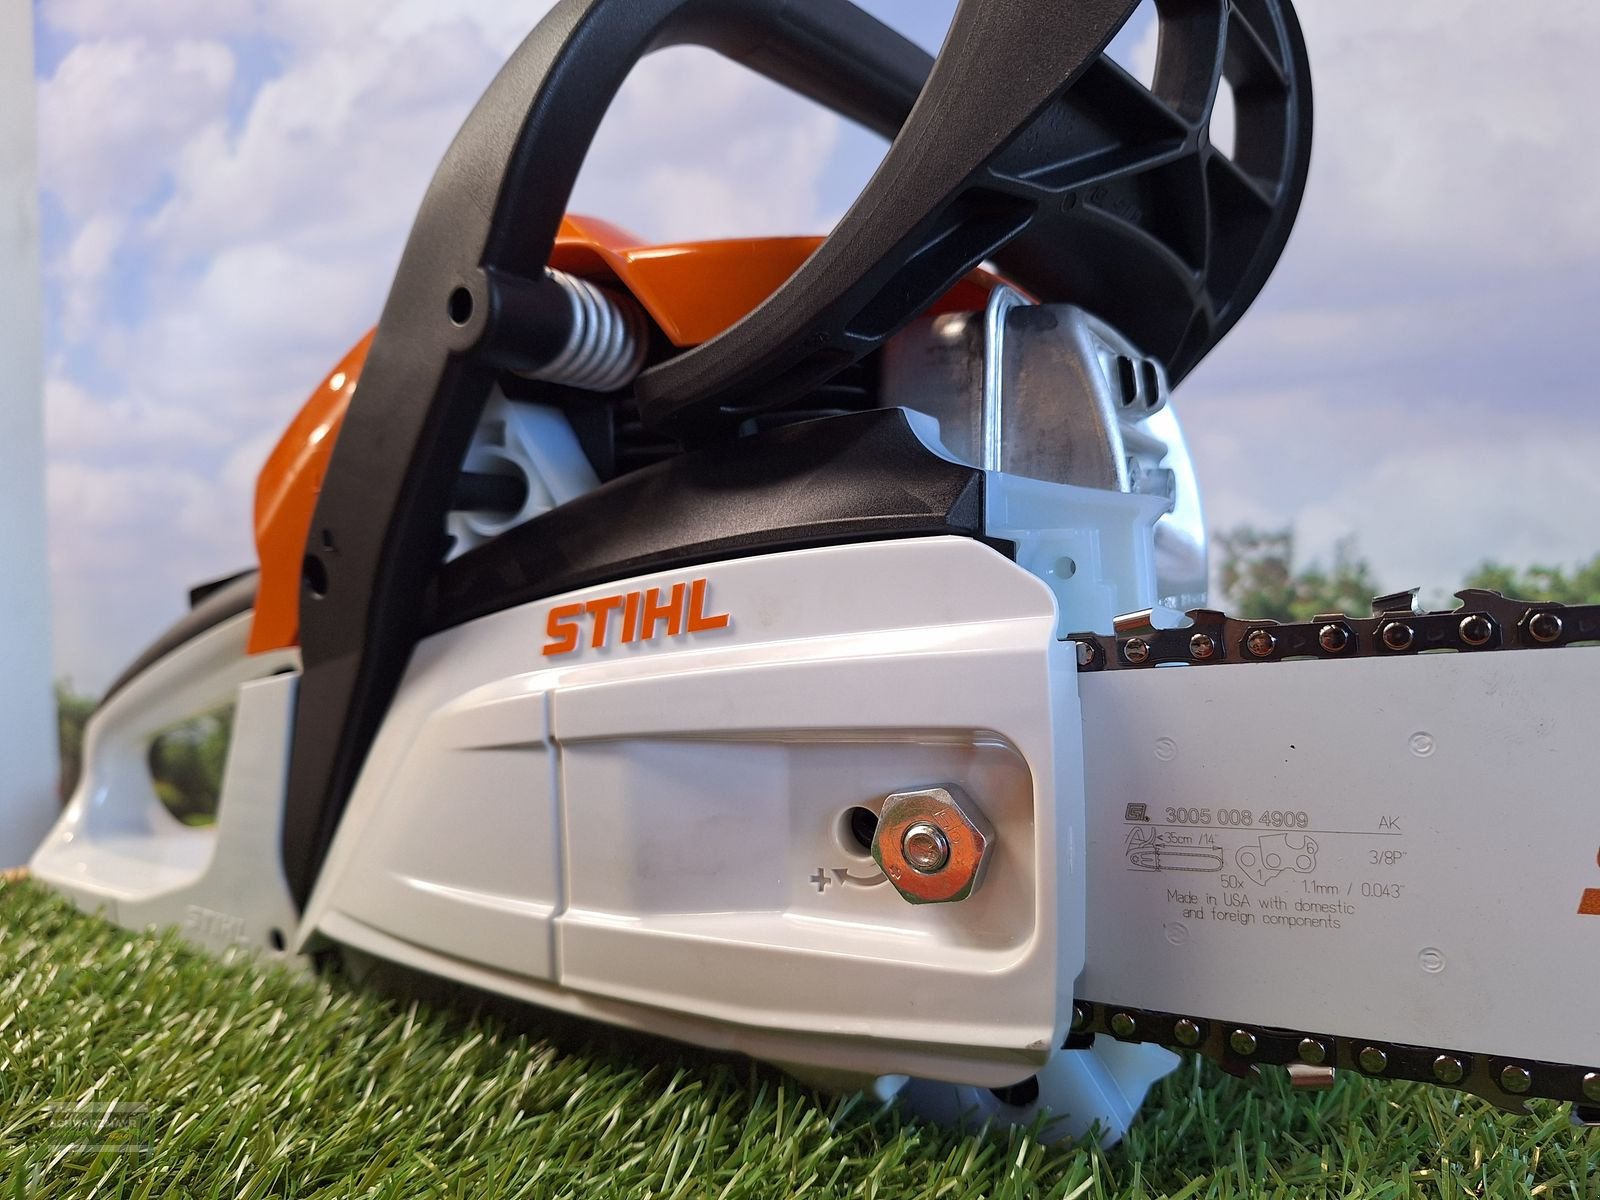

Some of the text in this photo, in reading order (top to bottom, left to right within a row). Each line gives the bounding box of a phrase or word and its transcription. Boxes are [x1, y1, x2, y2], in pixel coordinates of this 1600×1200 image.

[542, 578, 730, 656] STIHL
[1165, 806, 1309, 828] 3005 008 4909
[1378, 815, 1401, 830] AK
[1165, 831, 1193, 844] 35cm
[1220, 873, 1245, 889] 50x
[1302, 879, 1339, 895] 1.1mm
[1166, 888, 1356, 915] Made in USA with domestic
[1182, 906, 1342, 929] and foreign components
